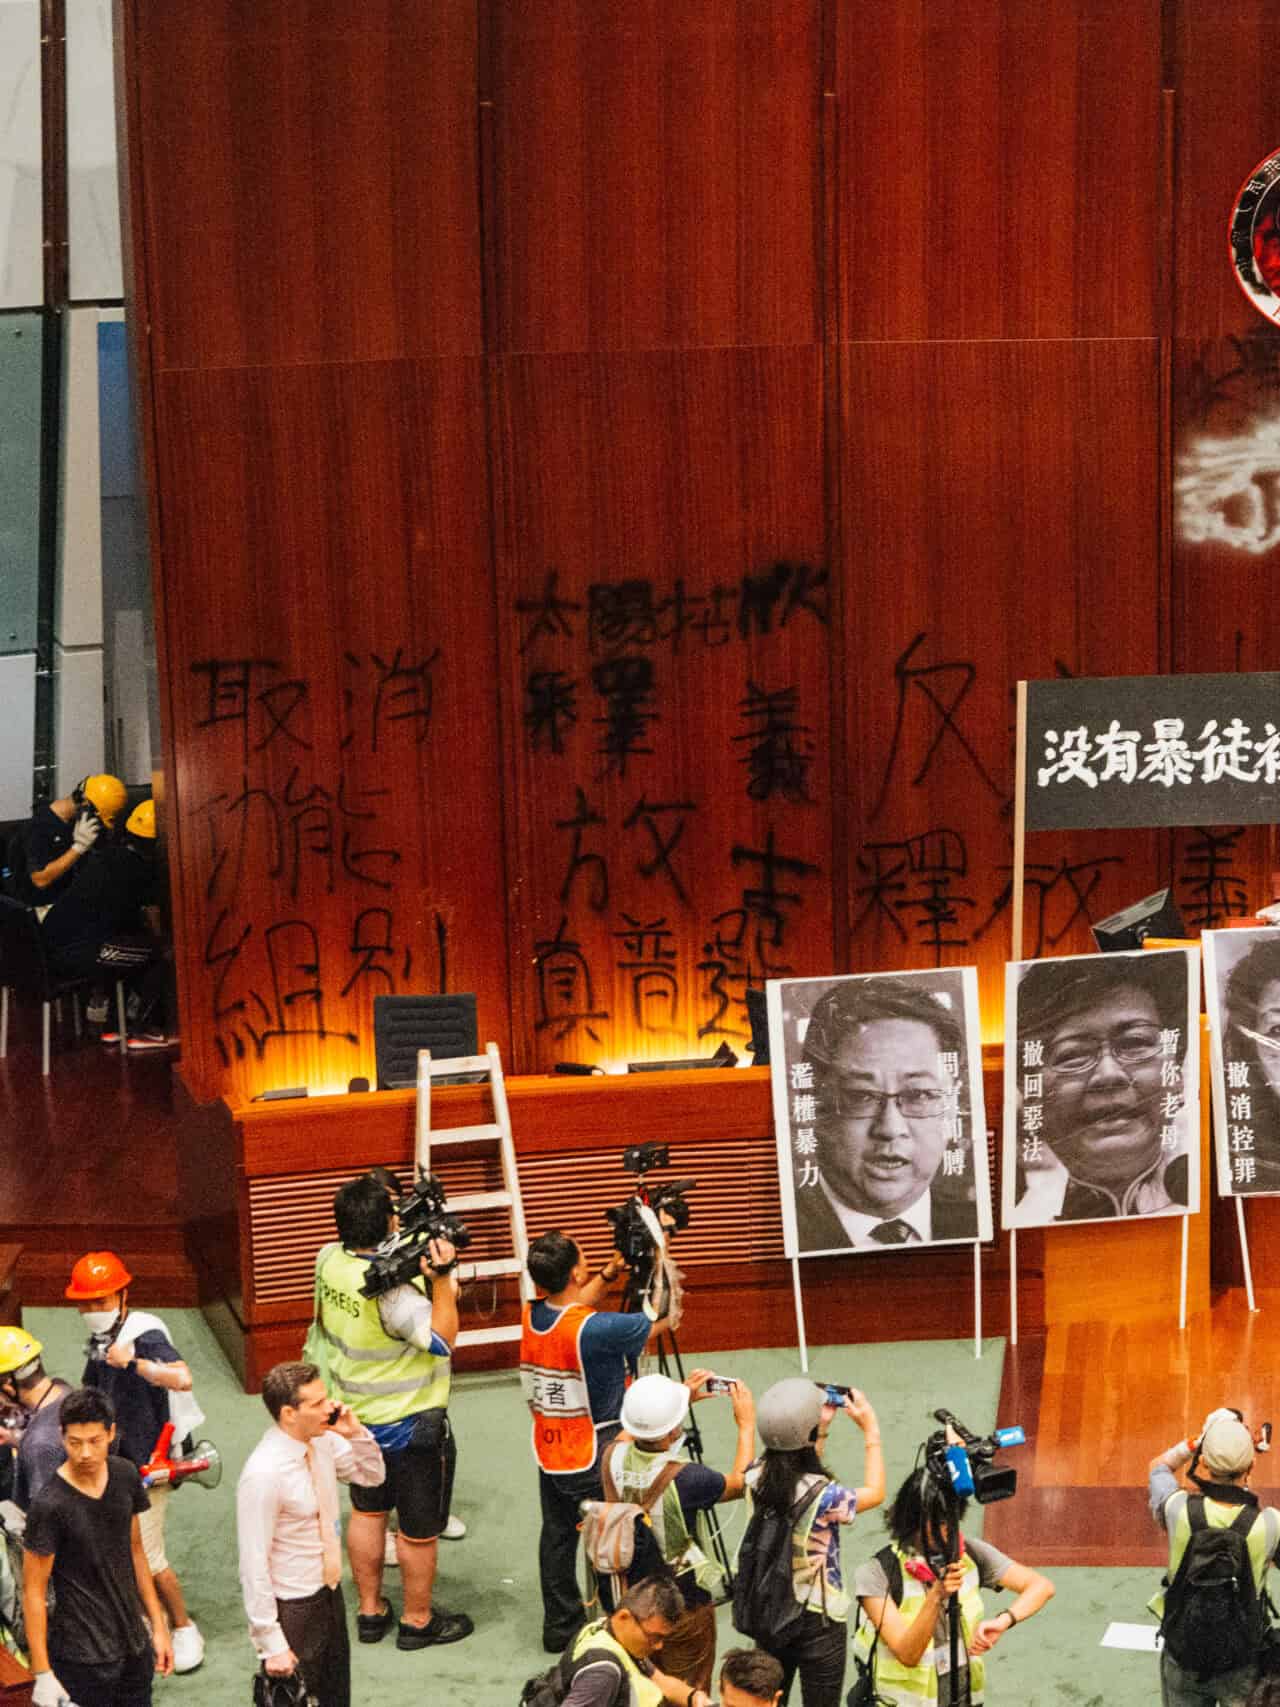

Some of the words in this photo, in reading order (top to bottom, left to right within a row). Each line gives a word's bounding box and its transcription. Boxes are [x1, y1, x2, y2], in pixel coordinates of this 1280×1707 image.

[190, 647, 440, 772] 取消
[204, 906, 448, 1067] 組別
[791, 1061, 821, 1188] 濫權暴力
[1023, 1039, 1045, 1162] 撤回惡法
